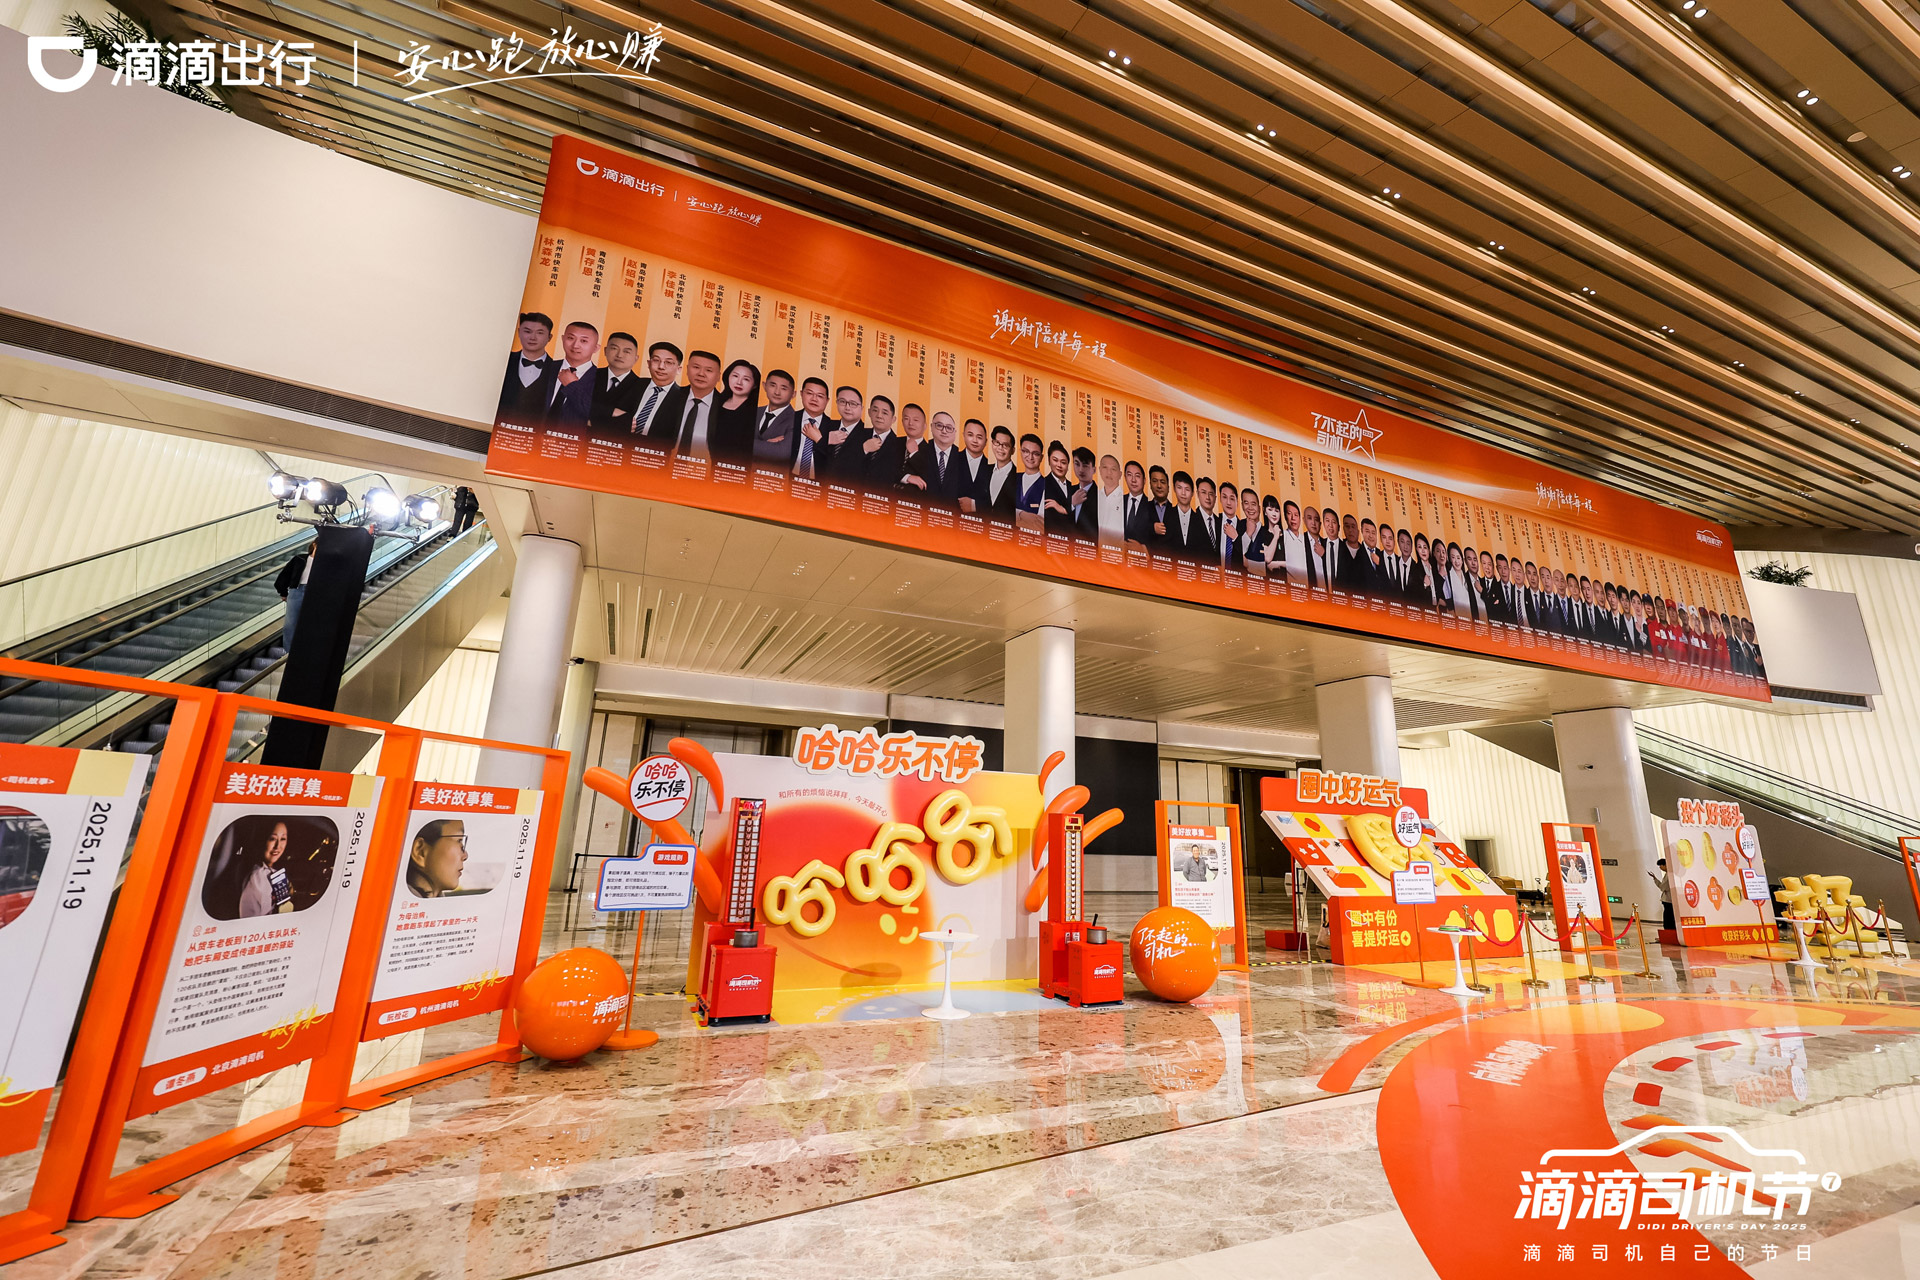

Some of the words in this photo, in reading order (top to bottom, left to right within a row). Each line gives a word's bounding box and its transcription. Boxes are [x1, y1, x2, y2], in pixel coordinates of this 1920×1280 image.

[601, 167, 665, 197] 滴滴出行
[549, 239, 565, 287] 杭州市快车司机
[582, 247, 597, 277] 黄存恩
[592, 251, 607, 298] 青岛市快车司机
[633, 262, 647, 310] 青岛市快车司机
[673, 273, 687, 319] 北京市快车司机
[712, 284, 725, 330] 北京市快车司机
[741, 291, 752, 319] 王志芳
[750, 294, 761, 340] 武汉市快车司机
[786, 305, 797, 349] 武汉市快车司机
[990, 308, 1116, 363] 谢谢陪伴每一程
[1310, 411, 1363, 442] 了不起的
[1316, 430, 1346, 453] 司机
[797, 730, 981, 780] 哈哈乐不停
[224, 772, 322, 799] 美好故事集
[644, 762, 680, 780] 哈哈
[419, 787, 495, 807] 美好故事集
[634, 779, 687, 800] 乐不停
[1299, 771, 1402, 806] 圈中好运气
[1397, 822, 1421, 834] 好运气
[1680, 800, 1744, 828] 投个好彩头
[62, 801, 112, 911] 2025.11.19
[341, 811, 366, 889] 2025.11.19
[513, 818, 531, 879] 2025.11.19
[1349, 909, 1398, 928] 圈中有份
[1137, 926, 1189, 947] 了不起的
[1351, 929, 1401, 948] 喜提好运
[1143, 937, 1186, 968] 司机
[210, 1050, 265, 1076] 北京滴滴司机
